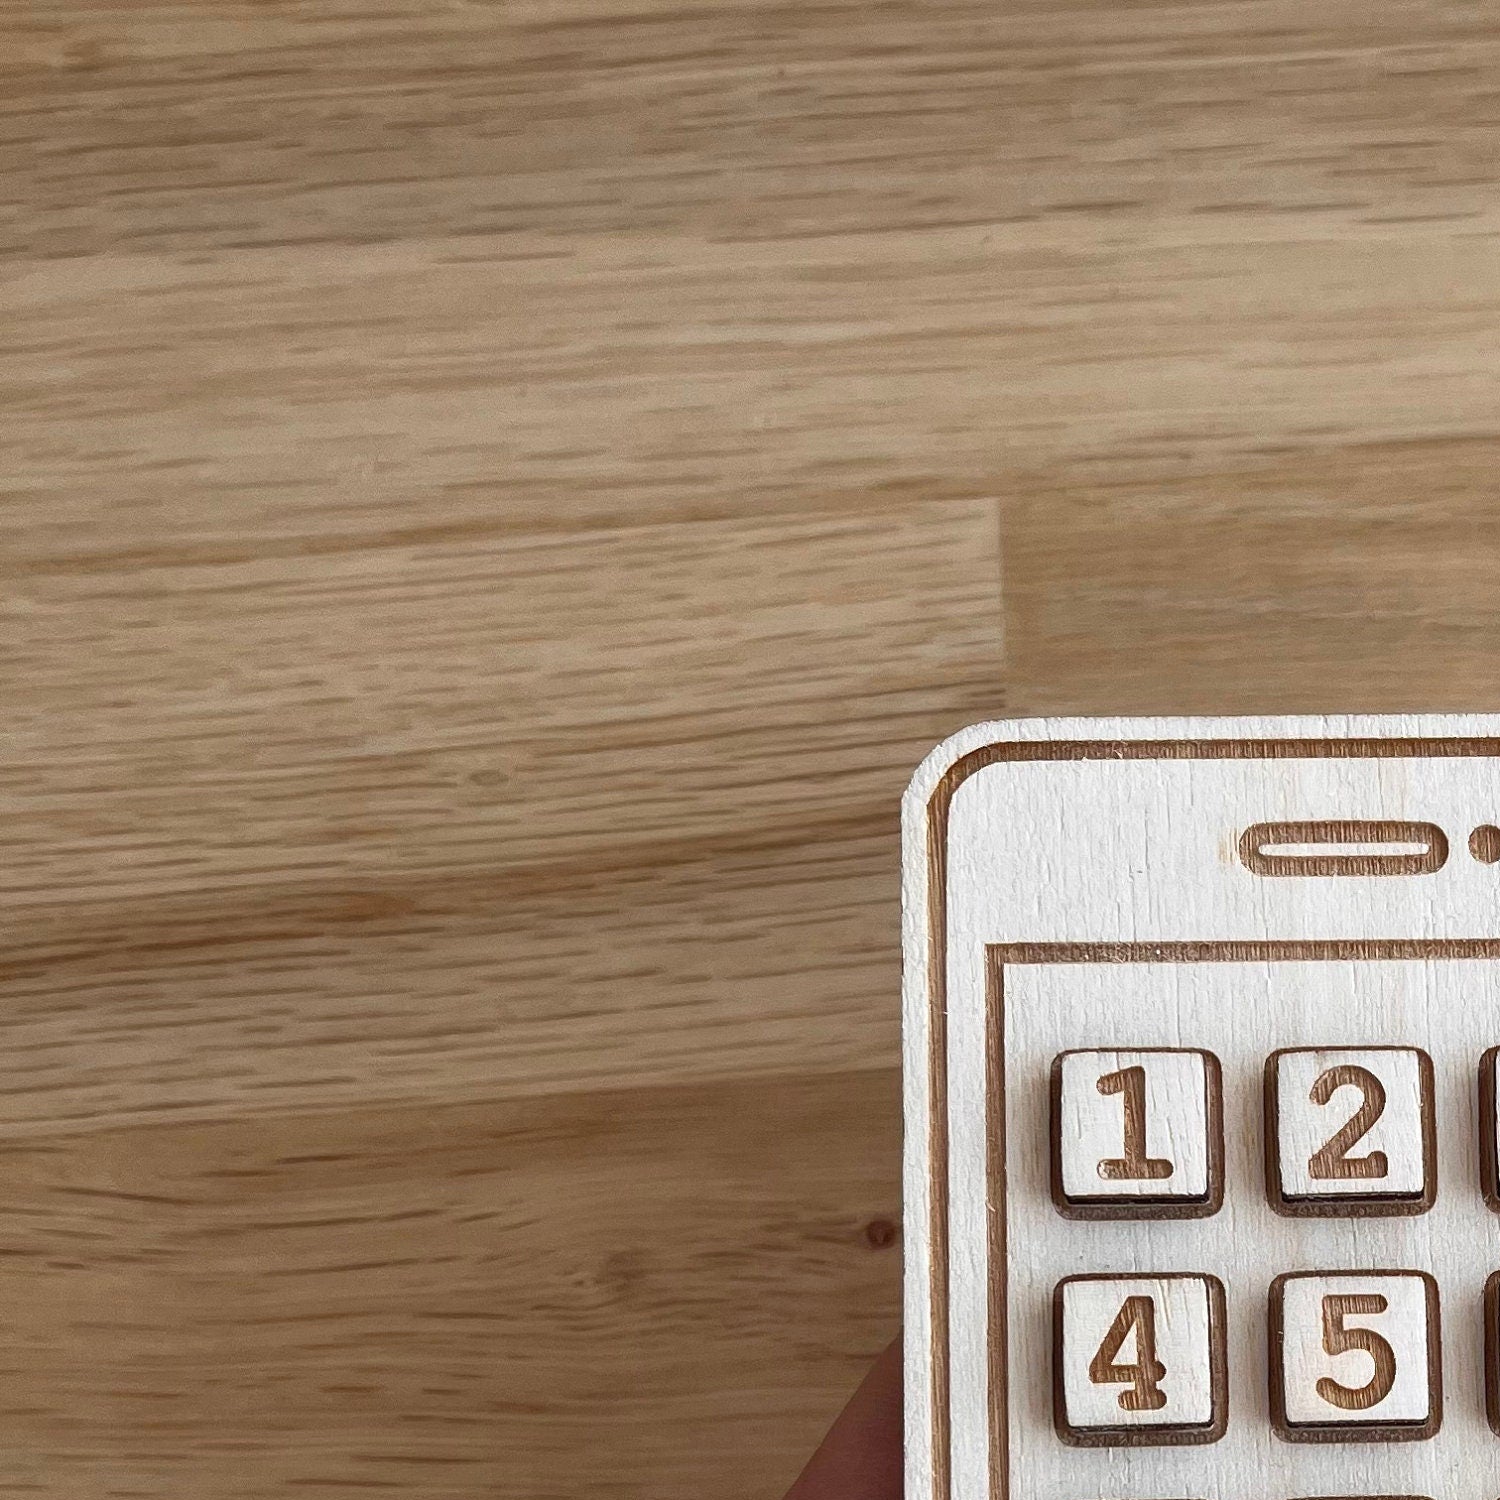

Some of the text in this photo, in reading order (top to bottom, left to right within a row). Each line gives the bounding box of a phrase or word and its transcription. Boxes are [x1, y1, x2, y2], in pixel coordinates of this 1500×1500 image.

[1096, 1065, 1175, 1180] 1
[1307, 1063, 1389, 1181] 2
[1088, 1295, 1168, 1412] 4
[1315, 1293, 1398, 1411] 5
